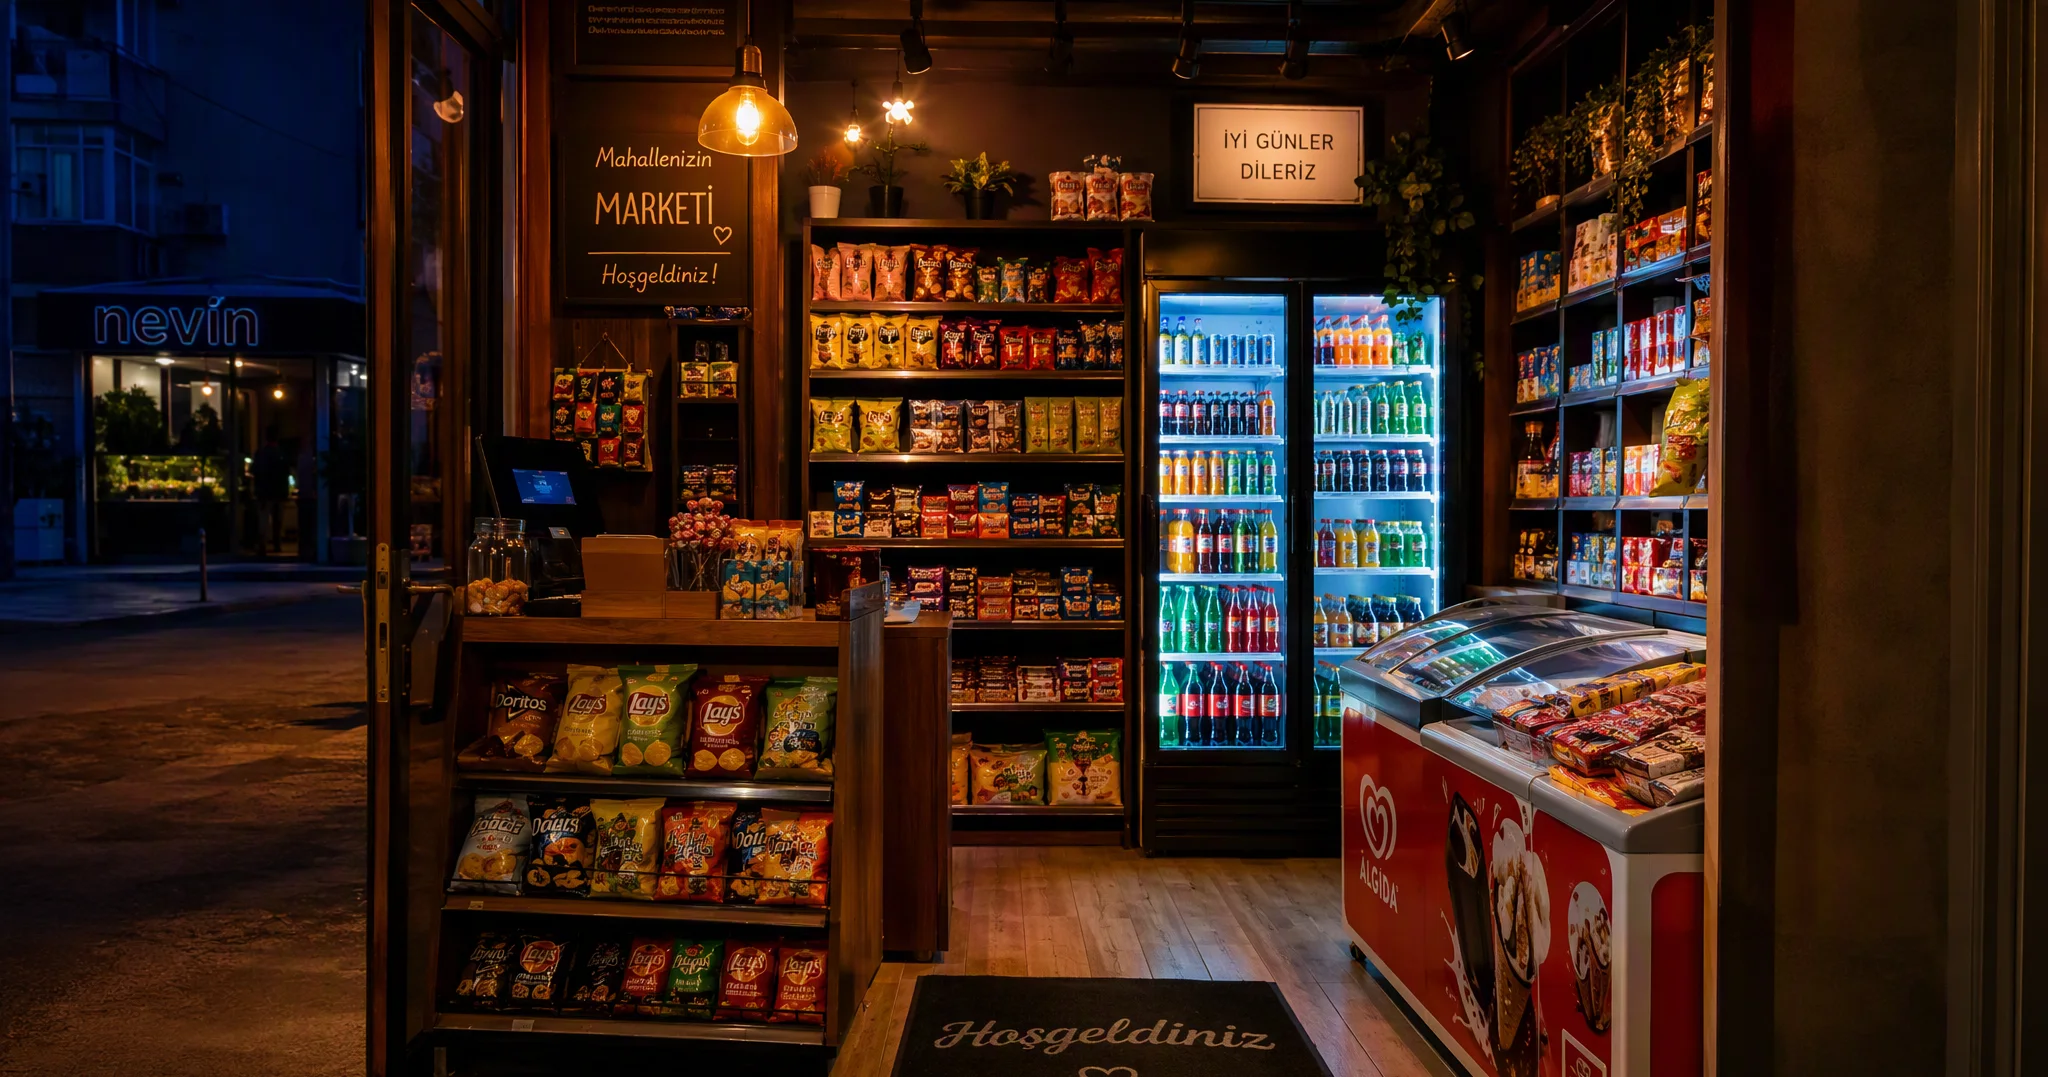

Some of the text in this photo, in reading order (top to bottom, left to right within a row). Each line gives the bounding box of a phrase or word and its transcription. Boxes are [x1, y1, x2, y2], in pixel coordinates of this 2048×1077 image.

[1223, 129, 1334, 151] İYİ GÜNLER
[595, 146, 712, 168] Mahallenizin
[1240, 159, 1316, 181] DİLERİZ
[595, 184, 713, 225] MARKETİ
[495, 693, 547, 711] Doritos
[934, 1017, 1276, 1055] Hoşgeldiniz
